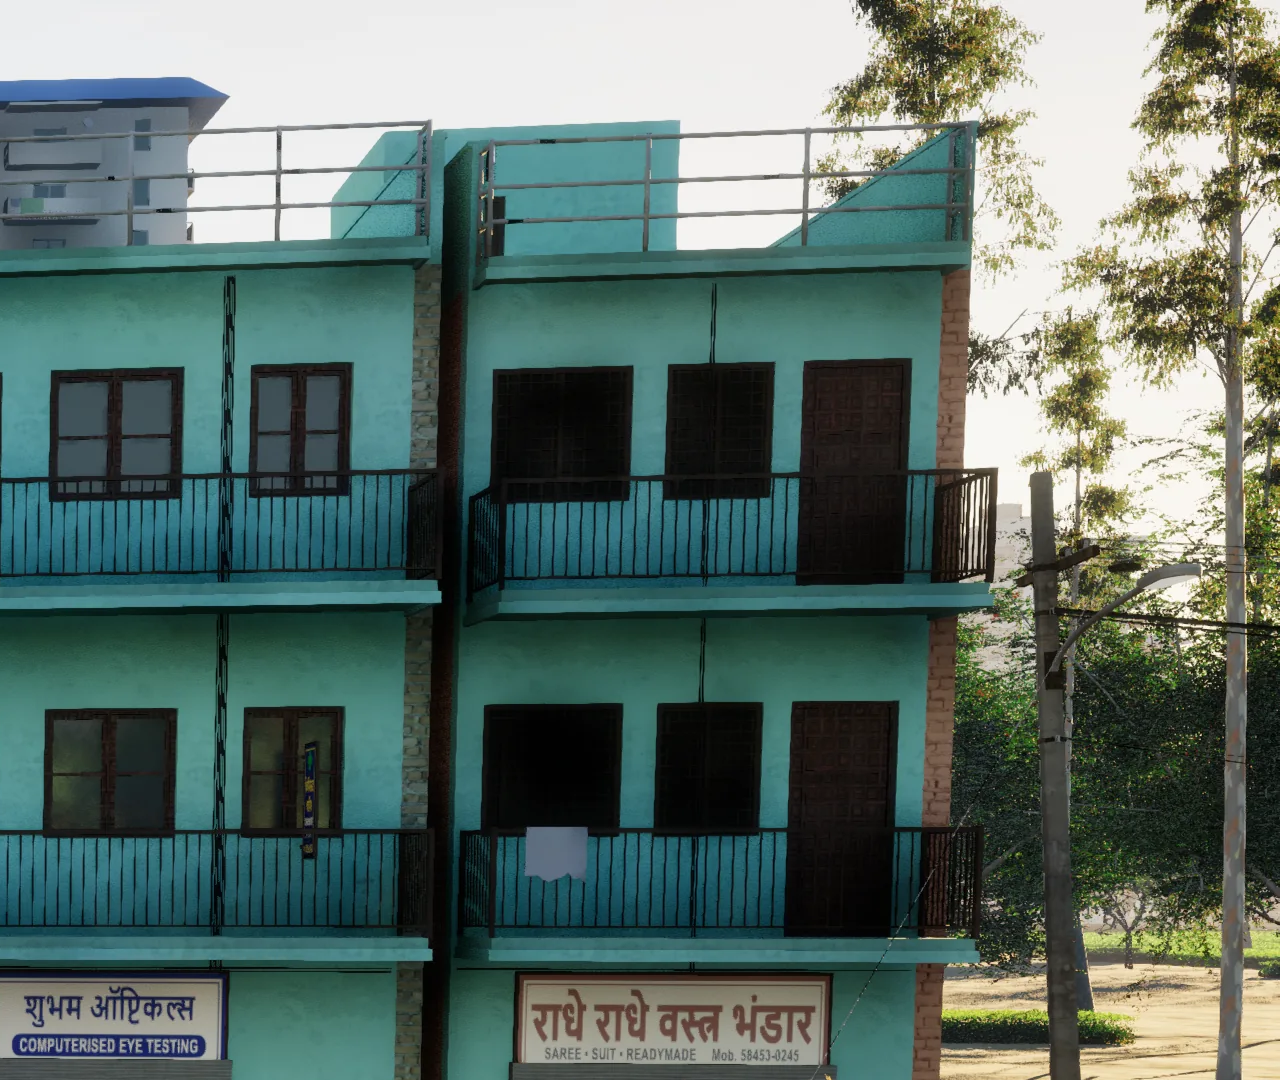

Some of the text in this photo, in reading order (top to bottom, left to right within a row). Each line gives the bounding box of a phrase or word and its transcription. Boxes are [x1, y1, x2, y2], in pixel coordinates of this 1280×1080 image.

[23, 986, 196, 1028] शुभम ऑप्टिकल्स
[530, 988, 817, 1045] राधे राधे वस्त्र भंडार
[19, 1036, 199, 1055] COMPUTERISED EYE TESTING
[544, 1047, 800, 1062] SAREE SUIT READYMADE Mob. 58453-0245
